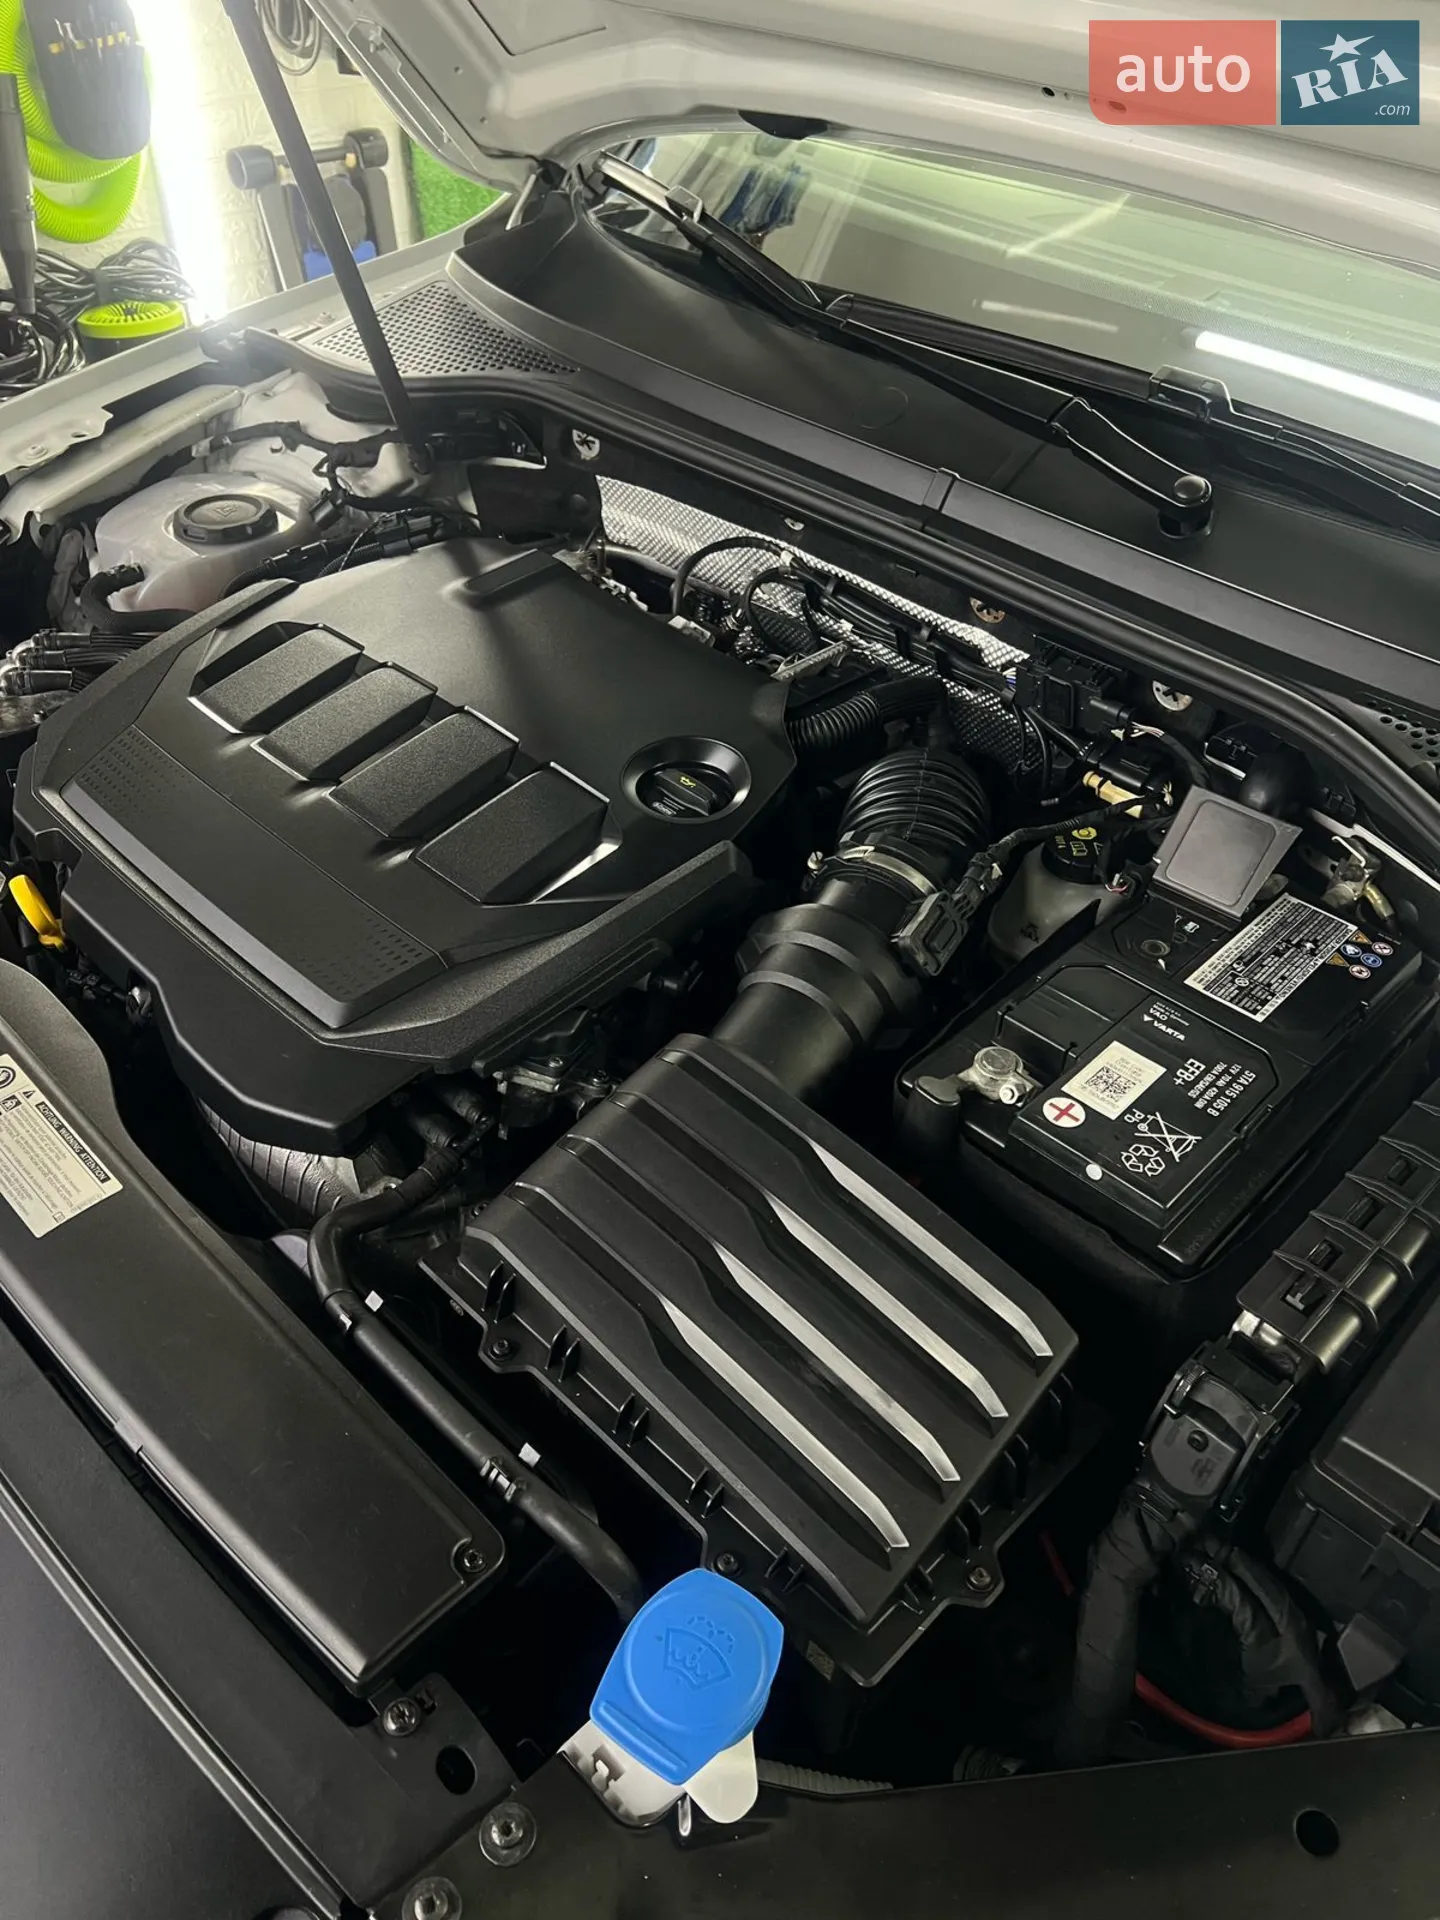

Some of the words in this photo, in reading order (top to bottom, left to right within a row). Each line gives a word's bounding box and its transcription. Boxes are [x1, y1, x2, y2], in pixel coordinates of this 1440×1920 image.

[1153, 1020, 1185, 1041] VARTA
[1173, 1057, 1206, 1086] EFB+
[1228, 1063, 1242, 1075] 12V
[1236, 1069, 1257, 1086] 5TA
[1224, 1082, 1244, 1099] 915
[1193, 1098, 1208, 1110] DIN
[1212, 1096, 1231, 1111] 105
[1123, 1108, 1145, 1124] Pb
[1206, 1107, 1220, 1117] B
[39, 1103, 62, 1129] ACHTUNG
[59, 1127, 83, 1154] WARNING
[80, 1151, 108, 1181] ATTENTION
